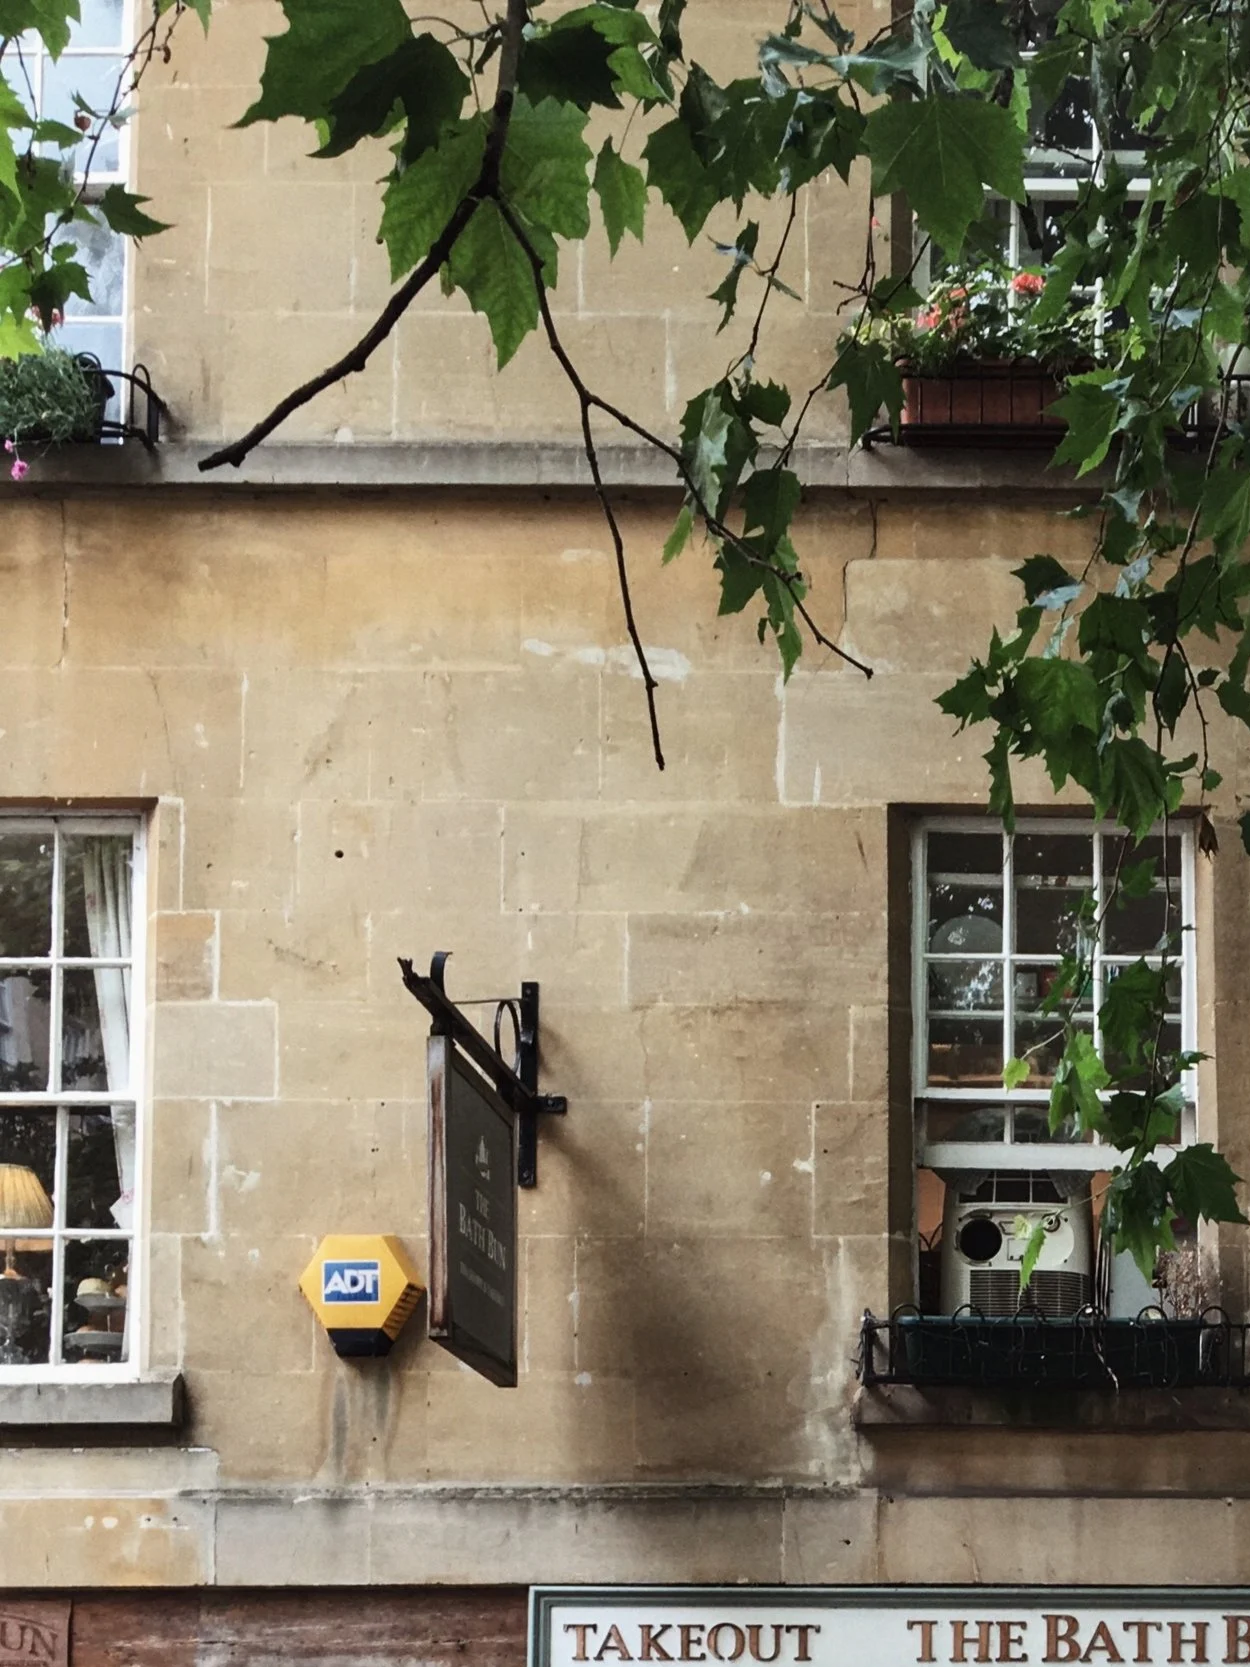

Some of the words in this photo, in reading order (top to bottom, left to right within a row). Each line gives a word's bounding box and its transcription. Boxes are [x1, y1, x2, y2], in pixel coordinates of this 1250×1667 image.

[475, 1188, 489, 1219] THE
[459, 1201, 486, 1253] BATH
[487, 1228, 506, 1271] BUN
[324, 1269, 379, 1294] ADT
[563, 1621, 821, 1662] TAKEOUT
[907, 1618, 1029, 1664] THE
[1041, 1613, 1210, 1664] BATH
